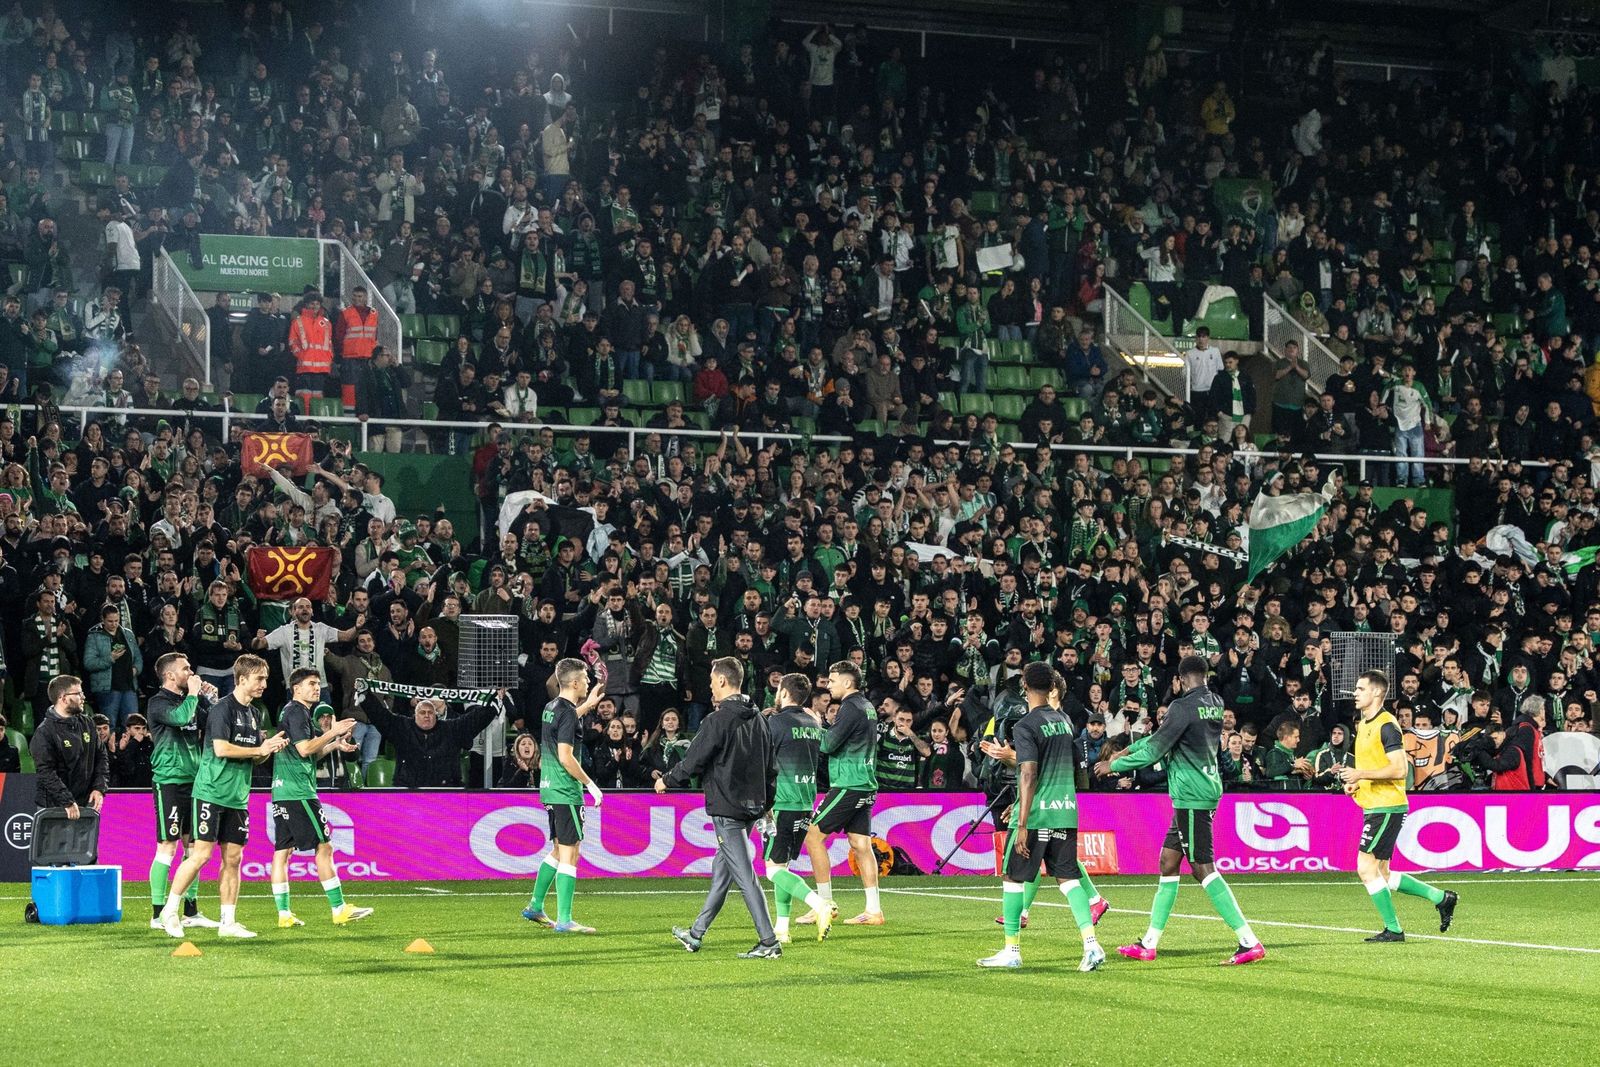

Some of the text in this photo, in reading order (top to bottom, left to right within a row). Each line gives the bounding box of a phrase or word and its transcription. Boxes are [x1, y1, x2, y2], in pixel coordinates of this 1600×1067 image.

[220, 254, 269, 267] RACING
[272, 256, 304, 268] CLUB
[220, 267, 269, 277] NUESTRO NORTE
[168, 806, 179, 822] 4
[200, 803, 211, 820] 5
[1083, 833, 1105, 856] REY
[1215, 856, 1340, 872] austral
